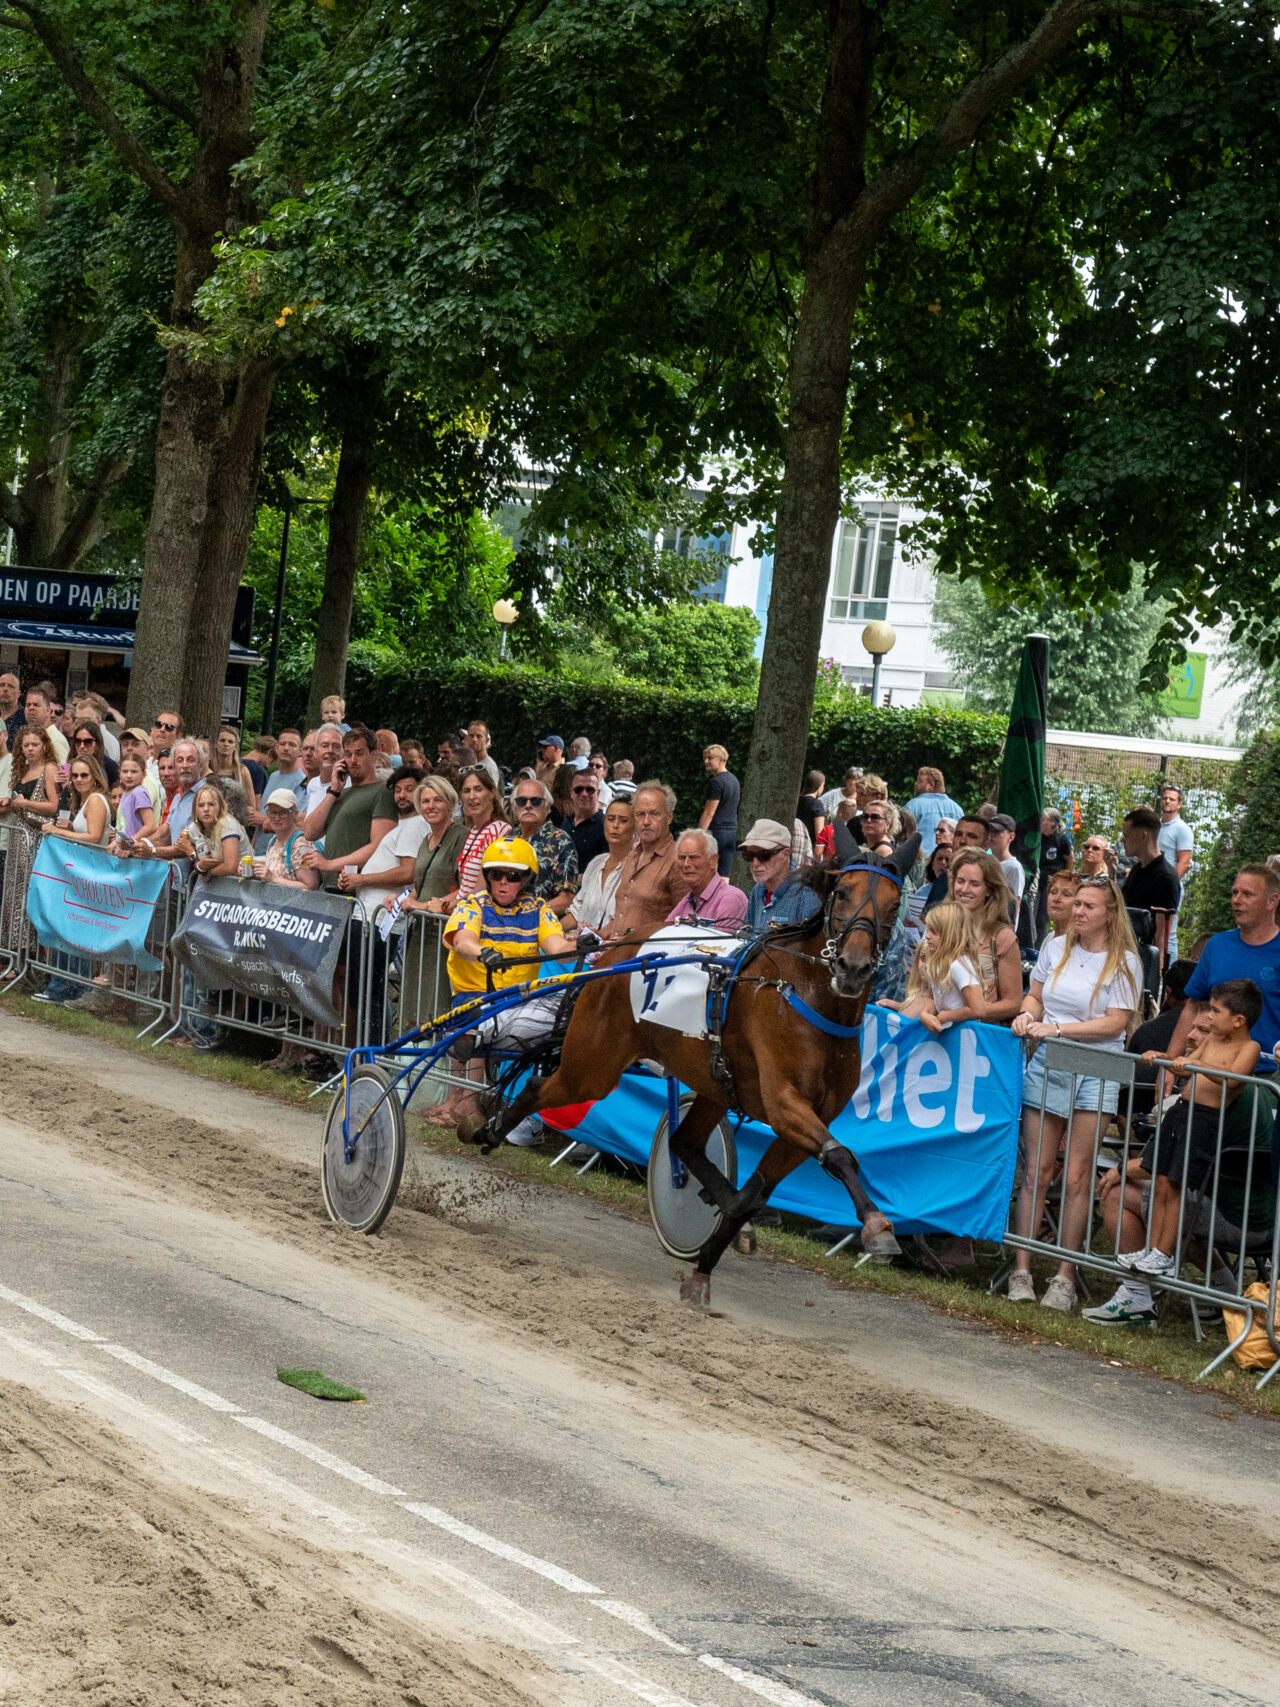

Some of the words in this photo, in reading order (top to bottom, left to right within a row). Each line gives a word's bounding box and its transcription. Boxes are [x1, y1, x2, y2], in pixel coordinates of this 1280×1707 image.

[36, 581, 61, 604] OP
[68, 584, 140, 611] PAARDE
[71, 875, 125, 909] SCHOUTEN
[194, 899, 333, 944] STUCADOORSBEDRIJF
[852, 1012, 991, 1133] liet
